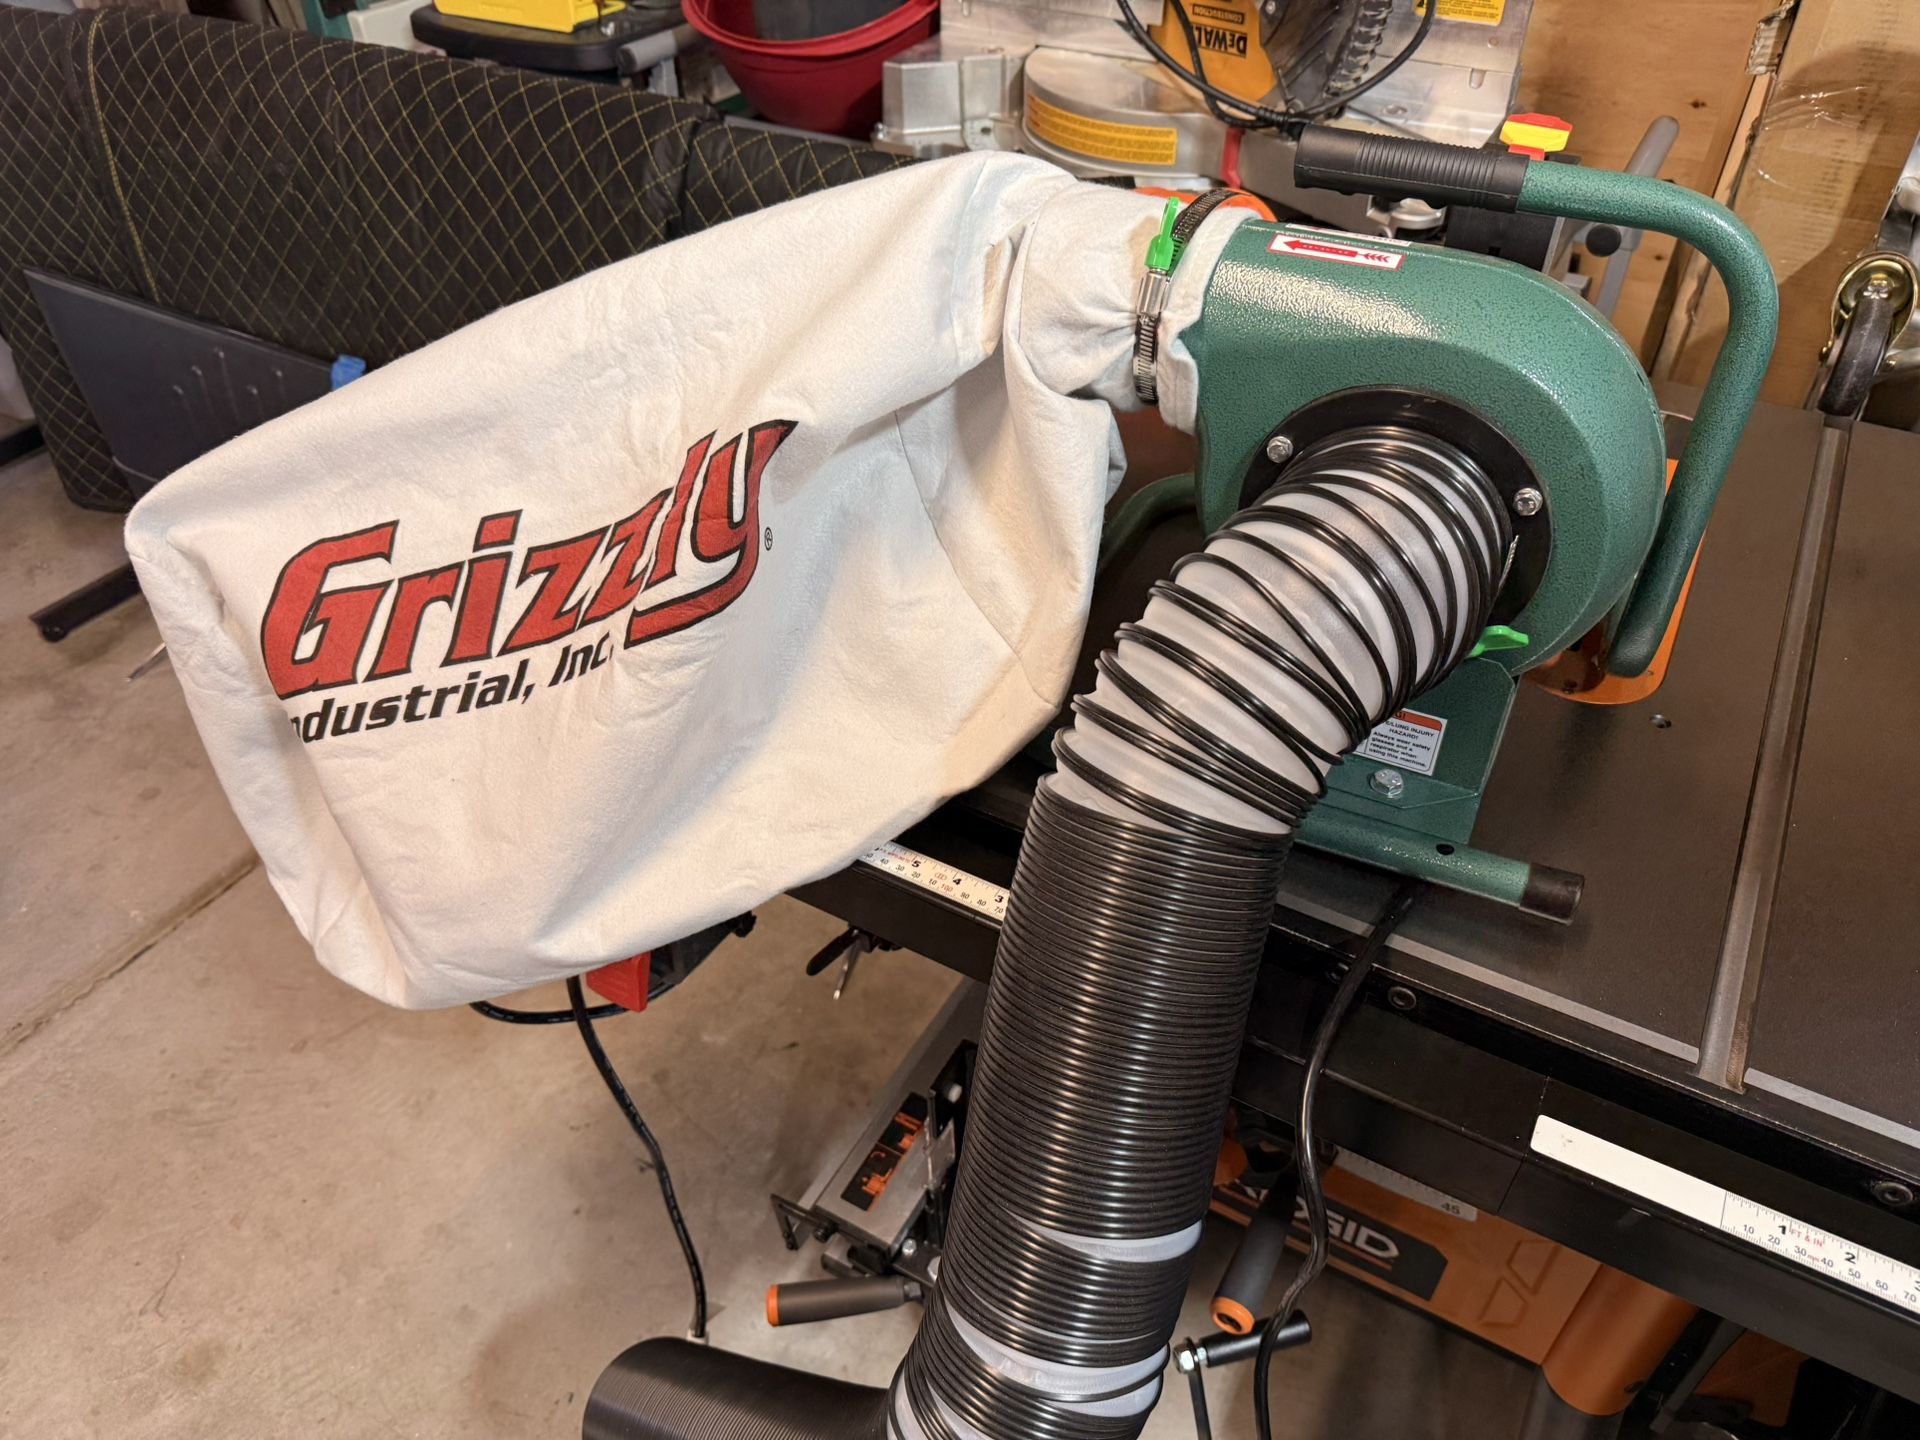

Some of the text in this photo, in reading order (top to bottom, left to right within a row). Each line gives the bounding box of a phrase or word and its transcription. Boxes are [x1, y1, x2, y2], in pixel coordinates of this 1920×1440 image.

[1195, 25, 1248, 55] DEWAL
[260, 418, 799, 700] Grizzly
[1410, 728, 1434, 737] INJURY
[911, 860, 921, 868] 5
[994, 895, 1004, 903] 3
[1441, 1202, 1461, 1215] 45
[1743, 1224, 1755, 1234] 10
[1767, 1234, 1781, 1246] 20
[1794, 1245, 1807, 1257] 30
[1820, 1257, 1834, 1268] 40
[1848, 1268, 1861, 1279] 50
[1875, 1279, 1889, 1291] 60
[1903, 1290, 1917, 1303] 70
[1778, 1224, 1787, 1235] 1
[1790, 1228, 1802, 1238] FT
[1813, 1238, 1823, 1247] IN
[1844, 1251, 1857, 1265] 2
